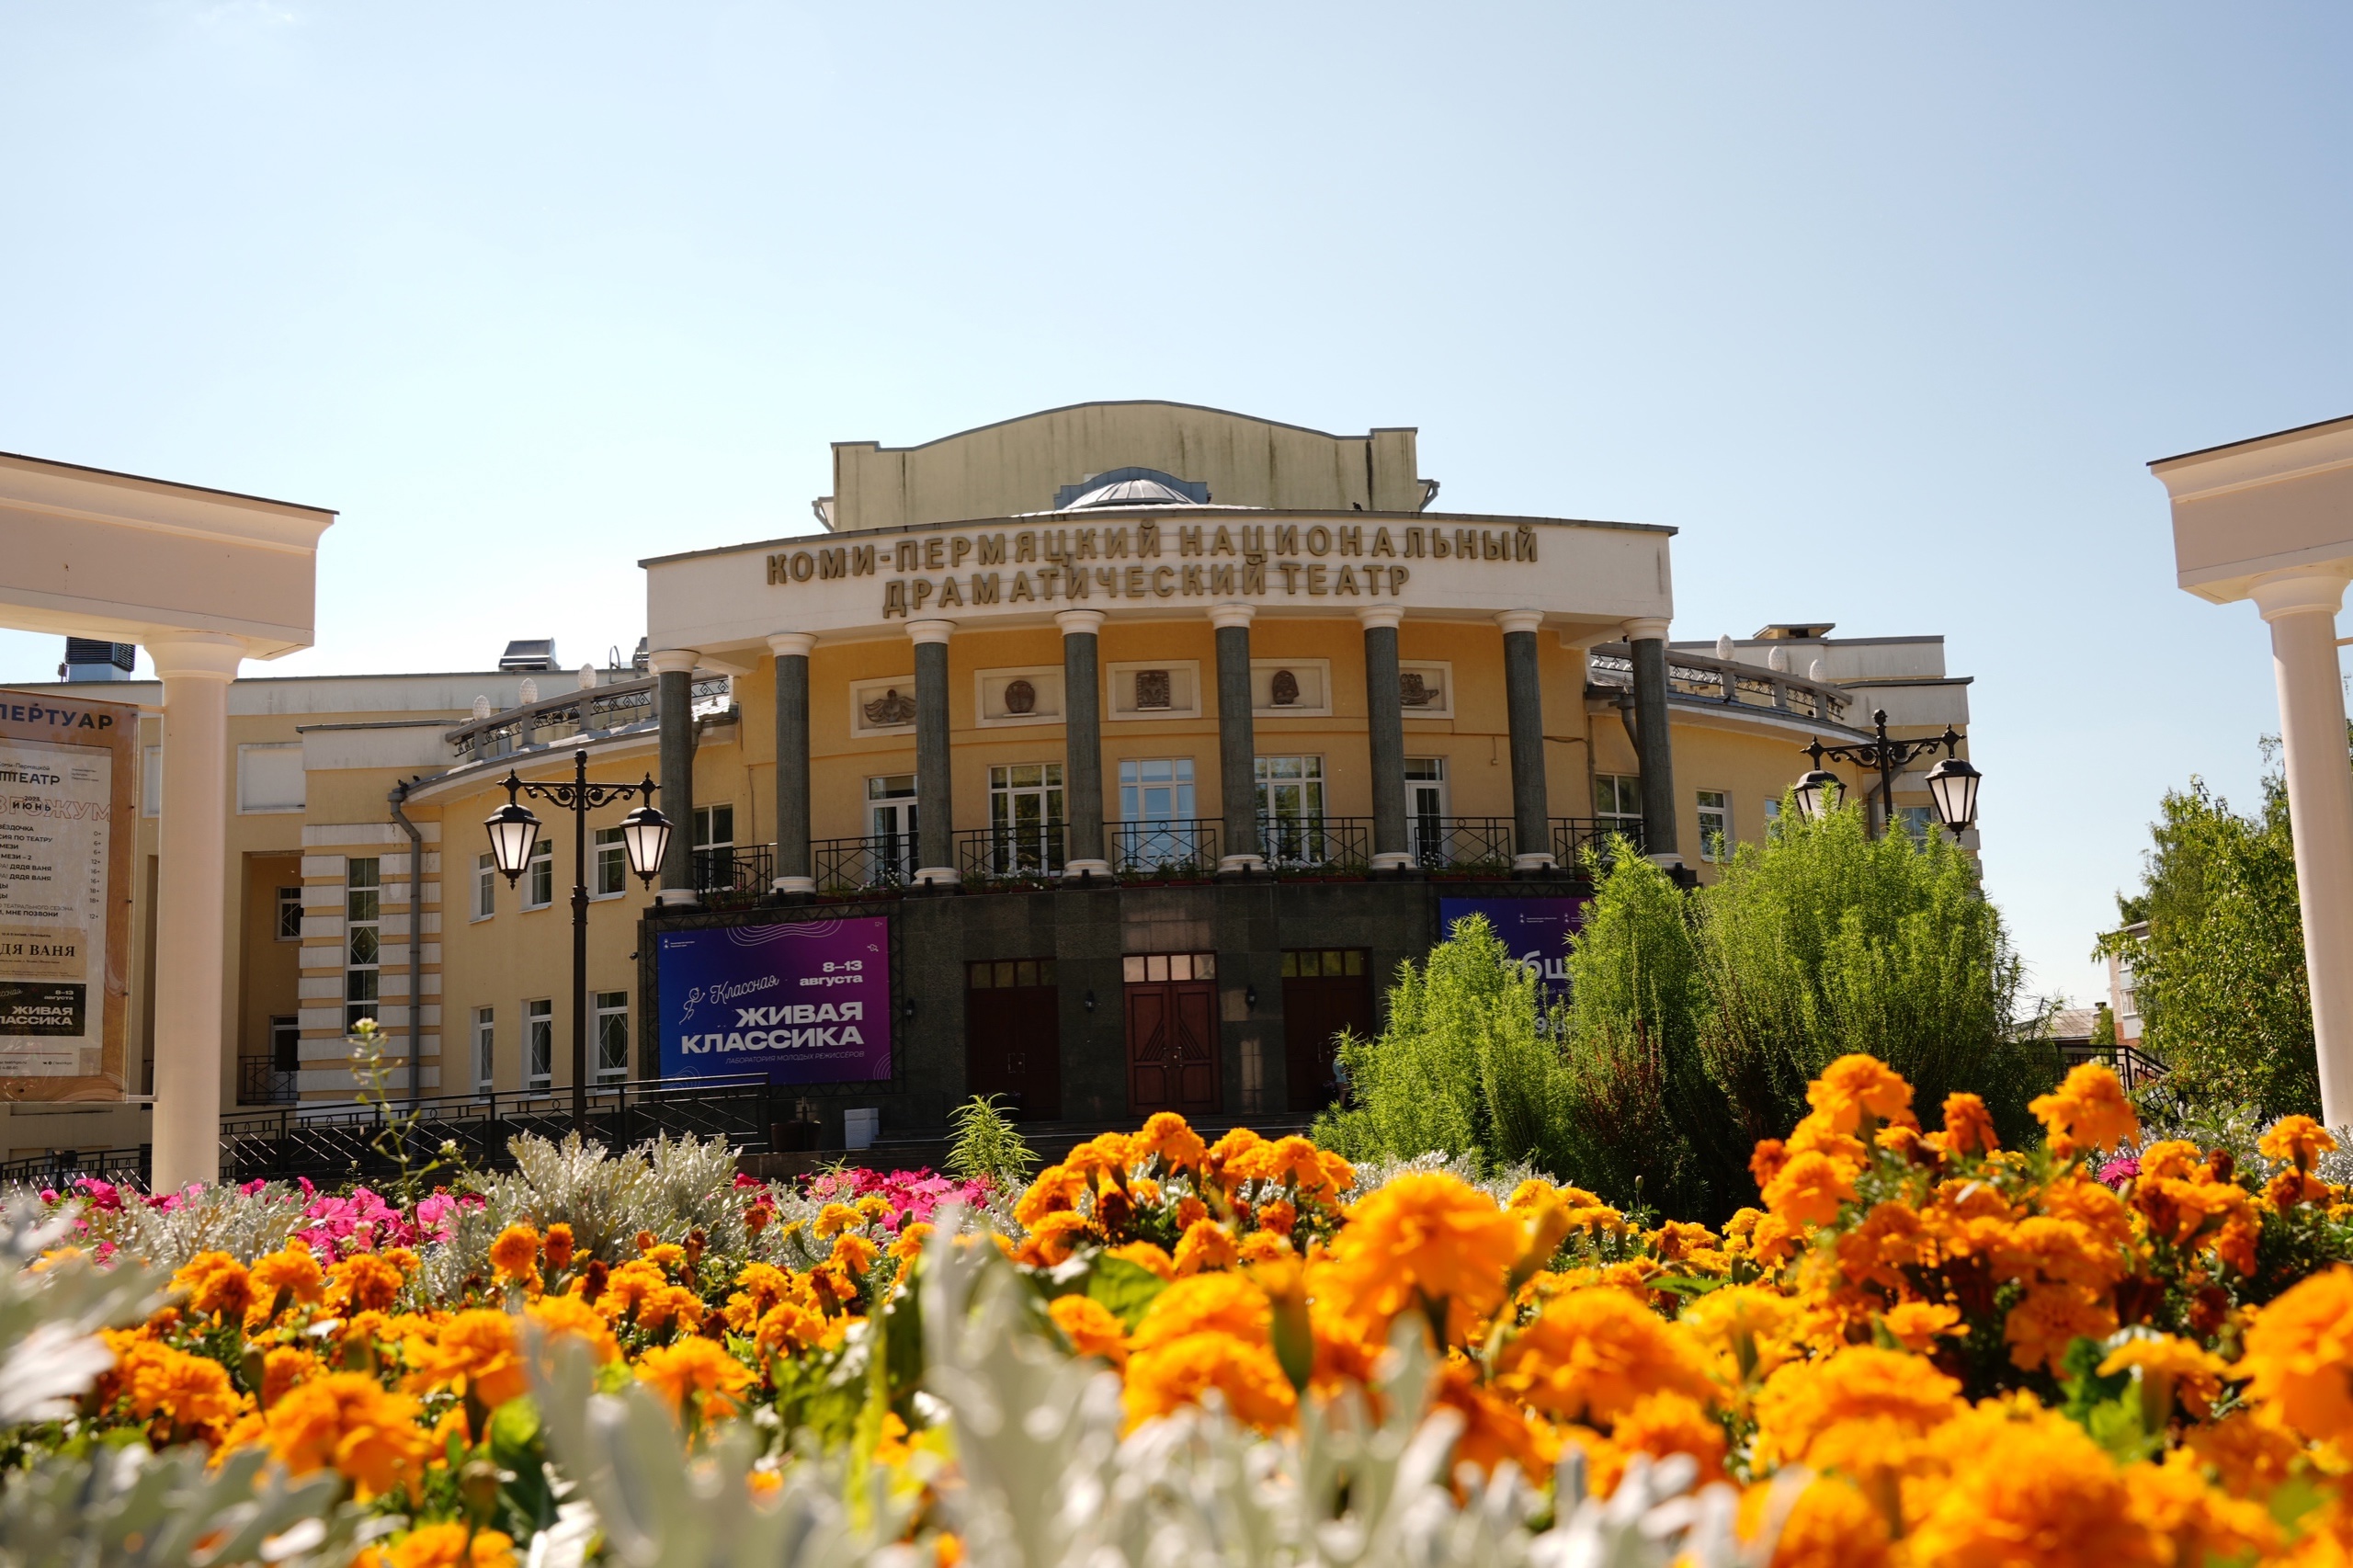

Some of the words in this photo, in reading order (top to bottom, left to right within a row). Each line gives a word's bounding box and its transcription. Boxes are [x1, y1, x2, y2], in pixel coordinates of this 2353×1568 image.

[767, 519, 1162, 585] КОМИ-ПЕРМЯЦКИЙ
[1179, 525, 1539, 562] НАЦИОНАЛЬНЫЙ
[882, 555, 1267, 619] ДРАМАТИЧЕСКИЙ
[1280, 562, 1410, 596] ТЕАТР
[13, 801, 51, 812] ИЮНЬ
[0, 944, 23, 956] ДЯ
[29, 944, 75, 957] ВАНЯ
[710, 974, 779, 1005] Классная
[800, 974, 863, 987] августа
[12, 1006, 74, 1016] ЖИВАЯ
[734, 1001, 863, 1028] ЖИВАЯ
[681, 1026, 865, 1054] КЛАССИКА
[725, 1055, 777, 1065] ЛАБОРАТОРИЯ
[777, 1052, 814, 1062] МОЛОДЫХ
